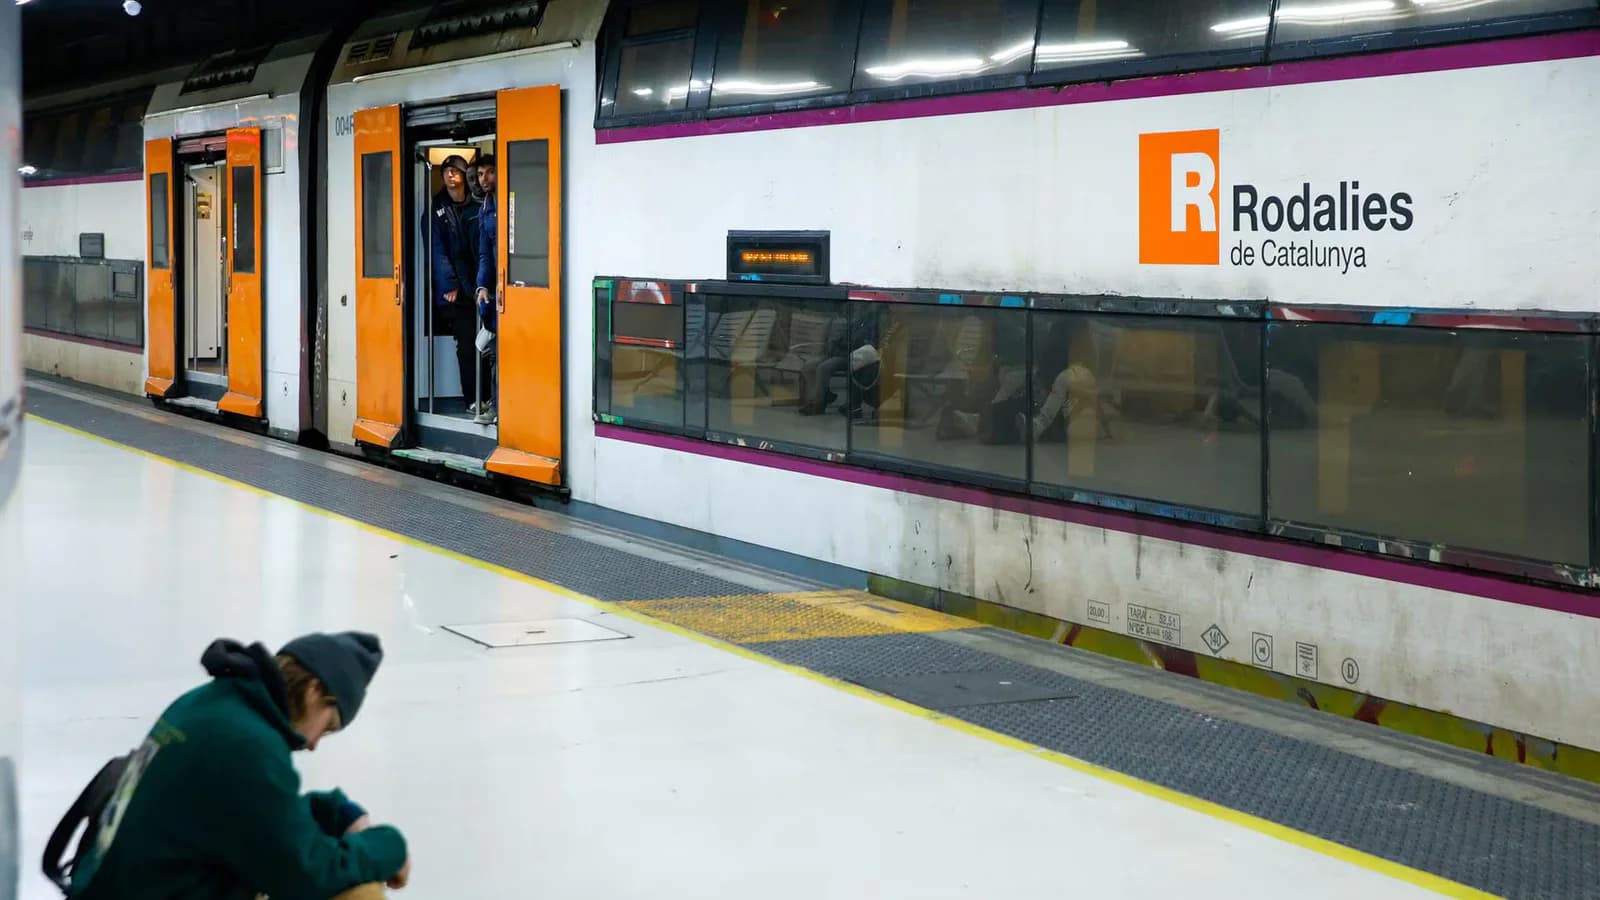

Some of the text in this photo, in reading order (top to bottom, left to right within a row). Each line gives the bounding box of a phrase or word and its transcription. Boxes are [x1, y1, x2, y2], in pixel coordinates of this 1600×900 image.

[1171, 152, 1216, 232] R
[1232, 181, 1414, 232] Rodalies
[1230, 239, 1367, 275] de Catalunya
[1129, 607, 1146, 619] TARA
[1209, 631, 1222, 647] 140
